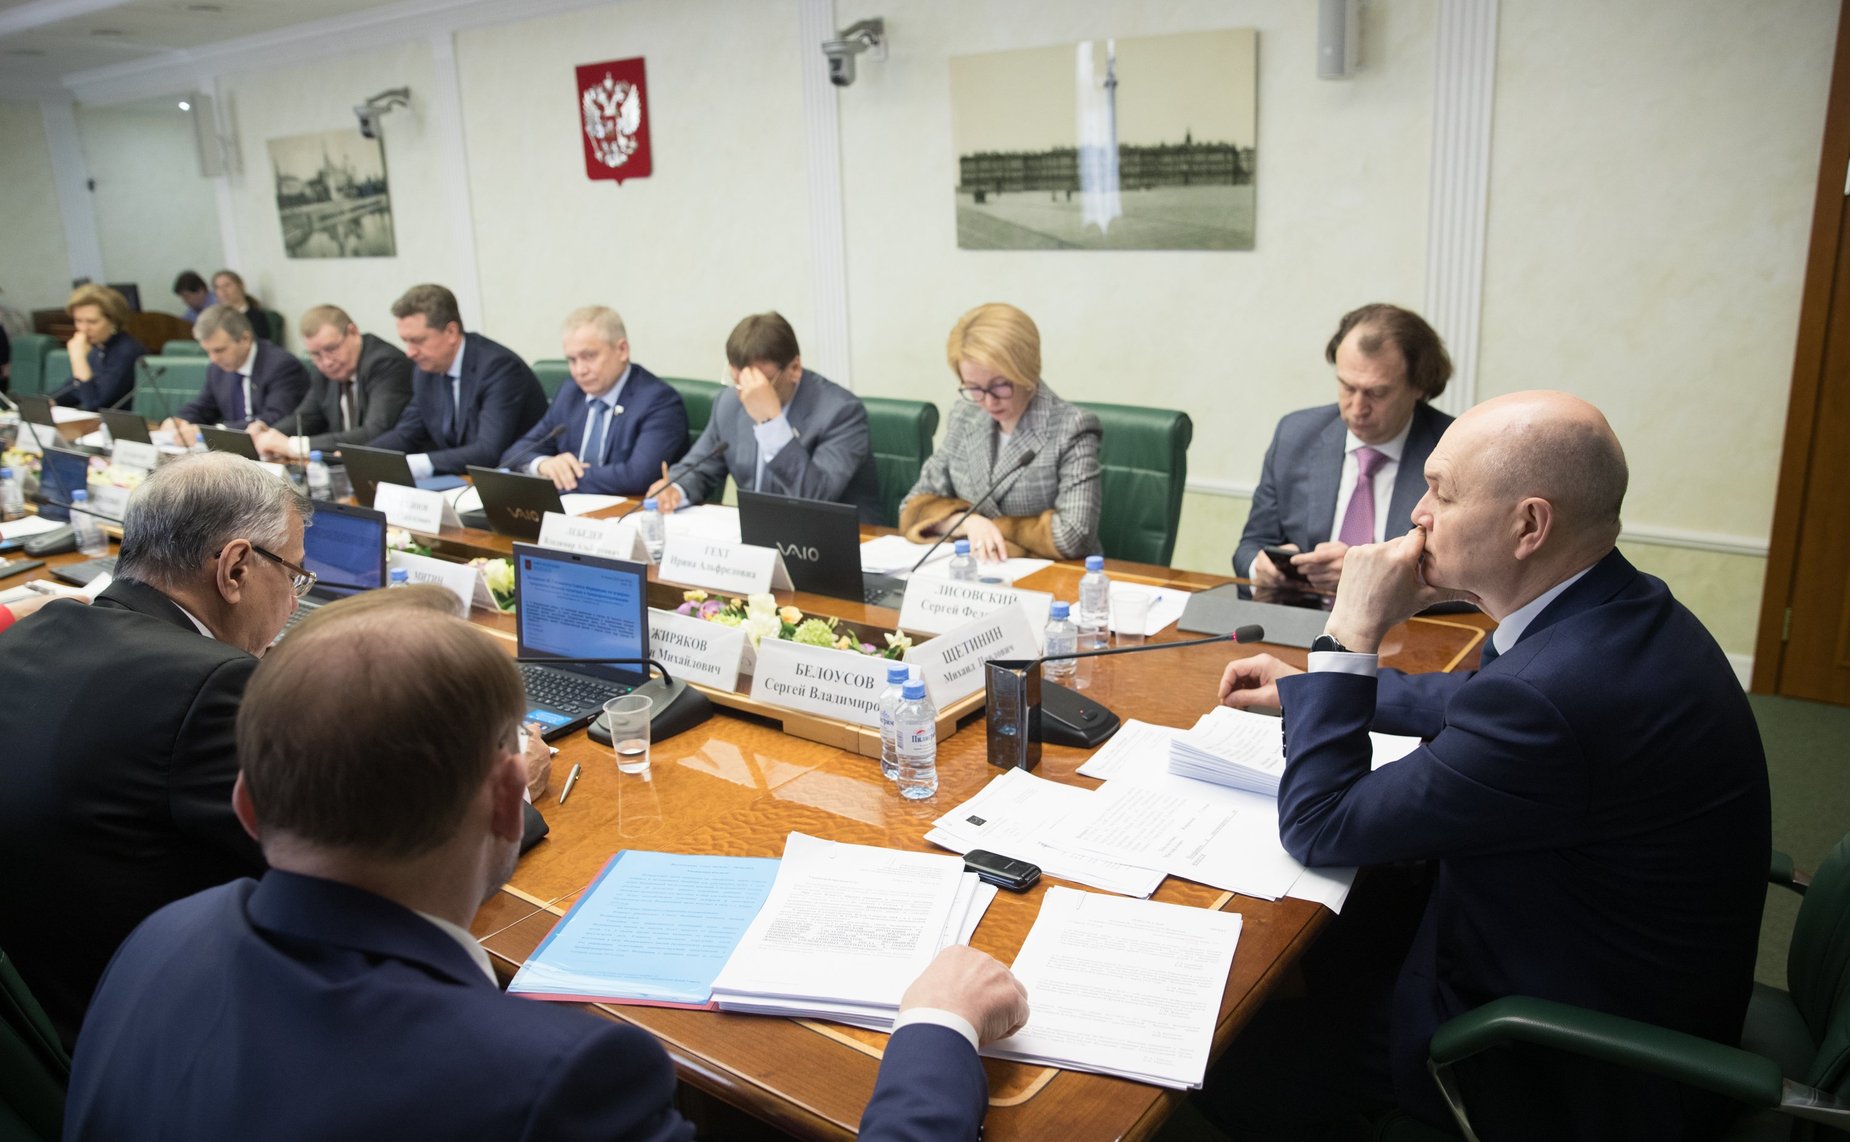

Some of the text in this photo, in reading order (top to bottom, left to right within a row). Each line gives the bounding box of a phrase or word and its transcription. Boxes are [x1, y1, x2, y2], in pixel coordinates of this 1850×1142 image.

[506, 506, 539, 522] VAIO
[776, 541, 820, 562] VAIO
[934, 584, 1018, 605] ЛИСОВСКИЙ
[921, 599, 959, 615] Сергей
[651, 627, 708, 652] ЖИРЯКОВ
[942, 626, 1003, 664] ЩЕТИНИН
[658, 647, 721, 675] Михайлович
[943, 663, 976, 682] Михаил
[795, 662, 875, 690] БЕЛОУСОВ
[764, 676, 880, 713] Сергей Владимиро
